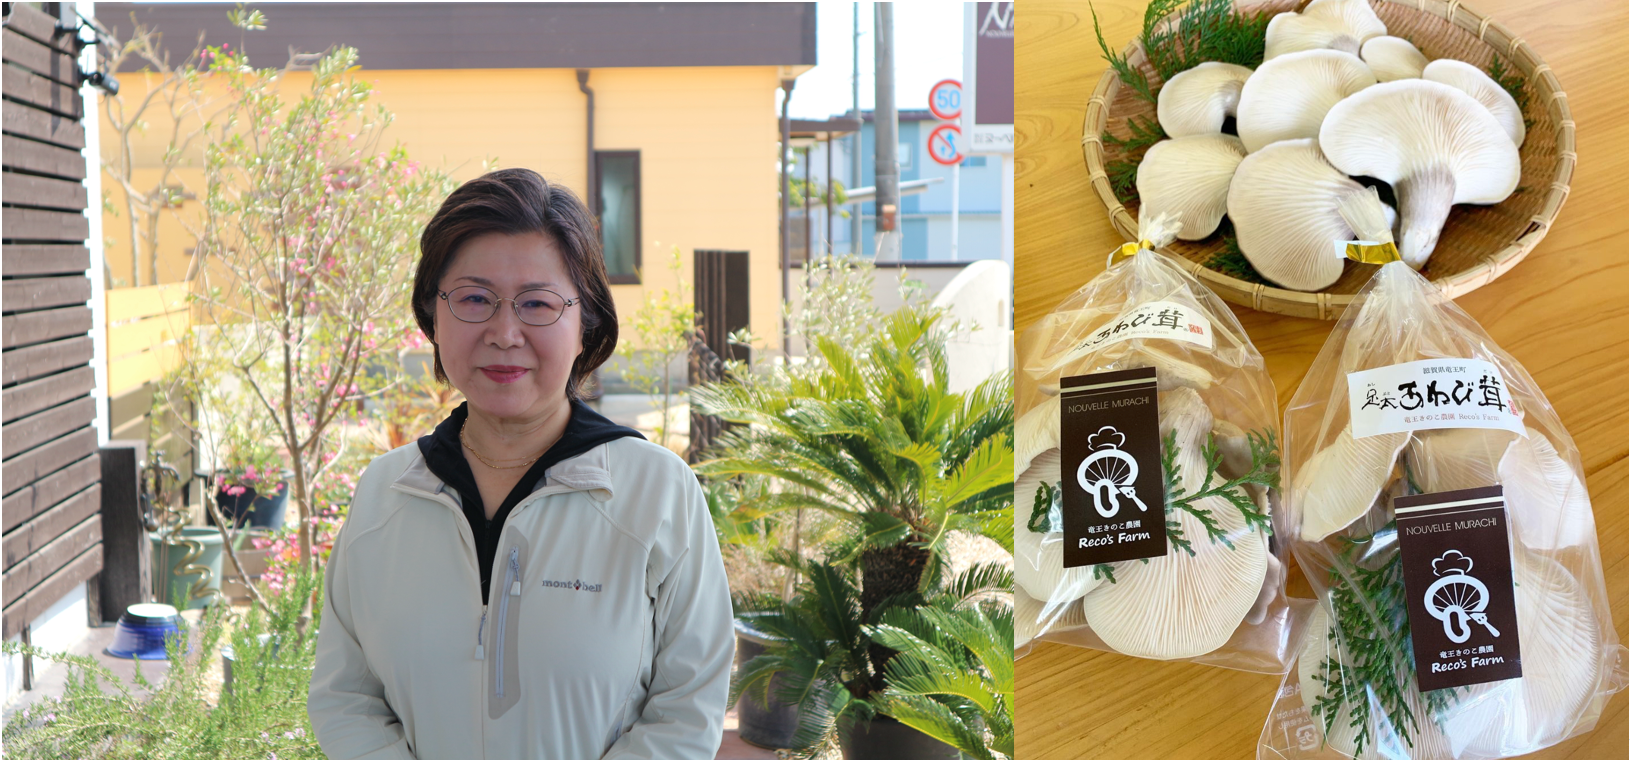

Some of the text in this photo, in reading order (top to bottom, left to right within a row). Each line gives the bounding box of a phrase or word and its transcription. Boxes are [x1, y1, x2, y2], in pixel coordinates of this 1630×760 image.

[937, 89, 961, 109] 50
[1422, 366, 1467, 374] 滋賀県竜王町
[1068, 396, 1150, 413] NOUVELLE MURACHI
[1404, 412, 1500, 424] 竜王きのこ農園 Reco's Farm
[1088, 520, 1141, 534] 竜王きのこ農園
[1406, 517, 1497, 536] NOUVELLE MURACHI
[1078, 531, 1151, 549] Reco's Farm
[1439, 645, 1494, 659] 竜王きのこ農園
[1431, 656, 1505, 674] Reco's Farm
